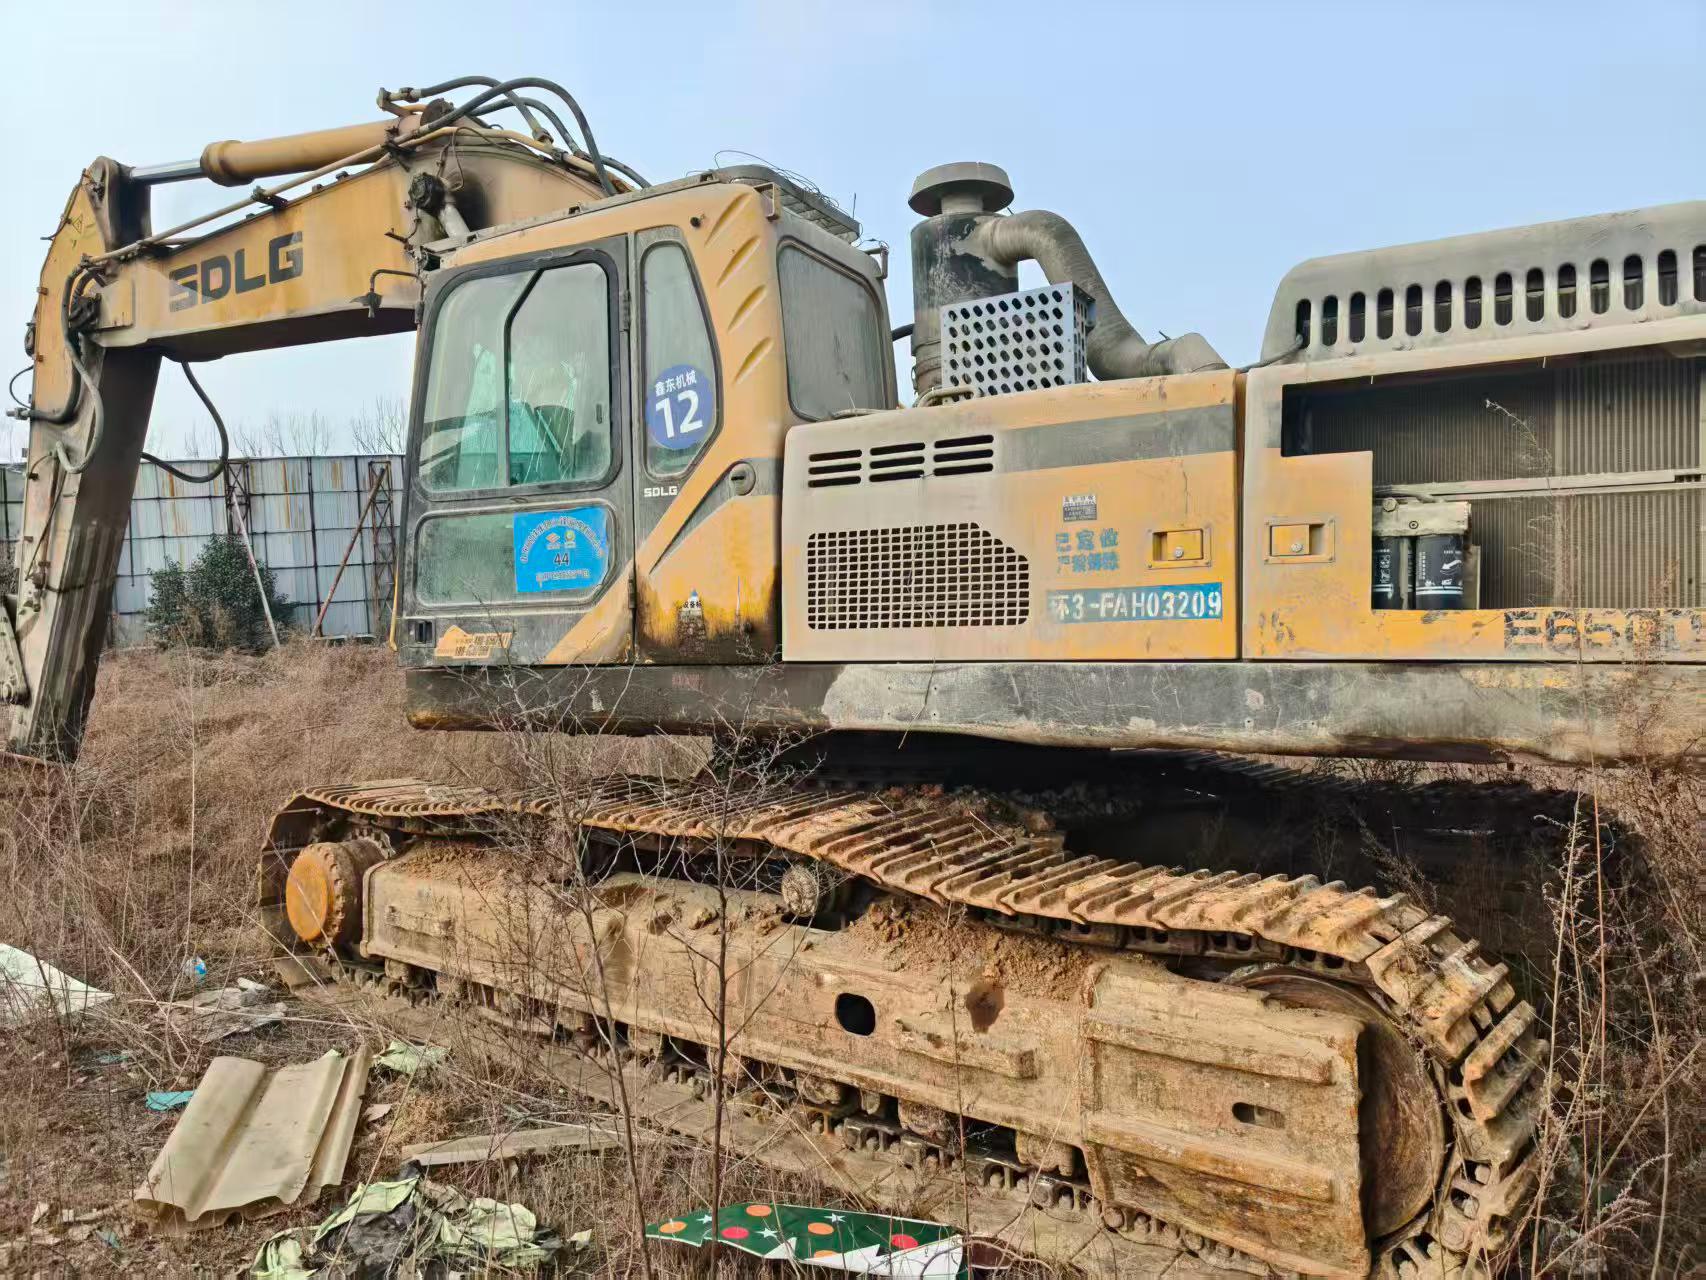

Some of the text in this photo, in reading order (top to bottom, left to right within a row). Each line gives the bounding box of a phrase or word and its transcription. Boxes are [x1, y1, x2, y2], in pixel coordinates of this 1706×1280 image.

[168, 230, 304, 313] SDLG
[655, 369, 698, 397] 鑫东机械
[655, 389, 704, 439] 12
[643, 485, 678, 498] SDLG
[553, 552, 570, 567] 44
